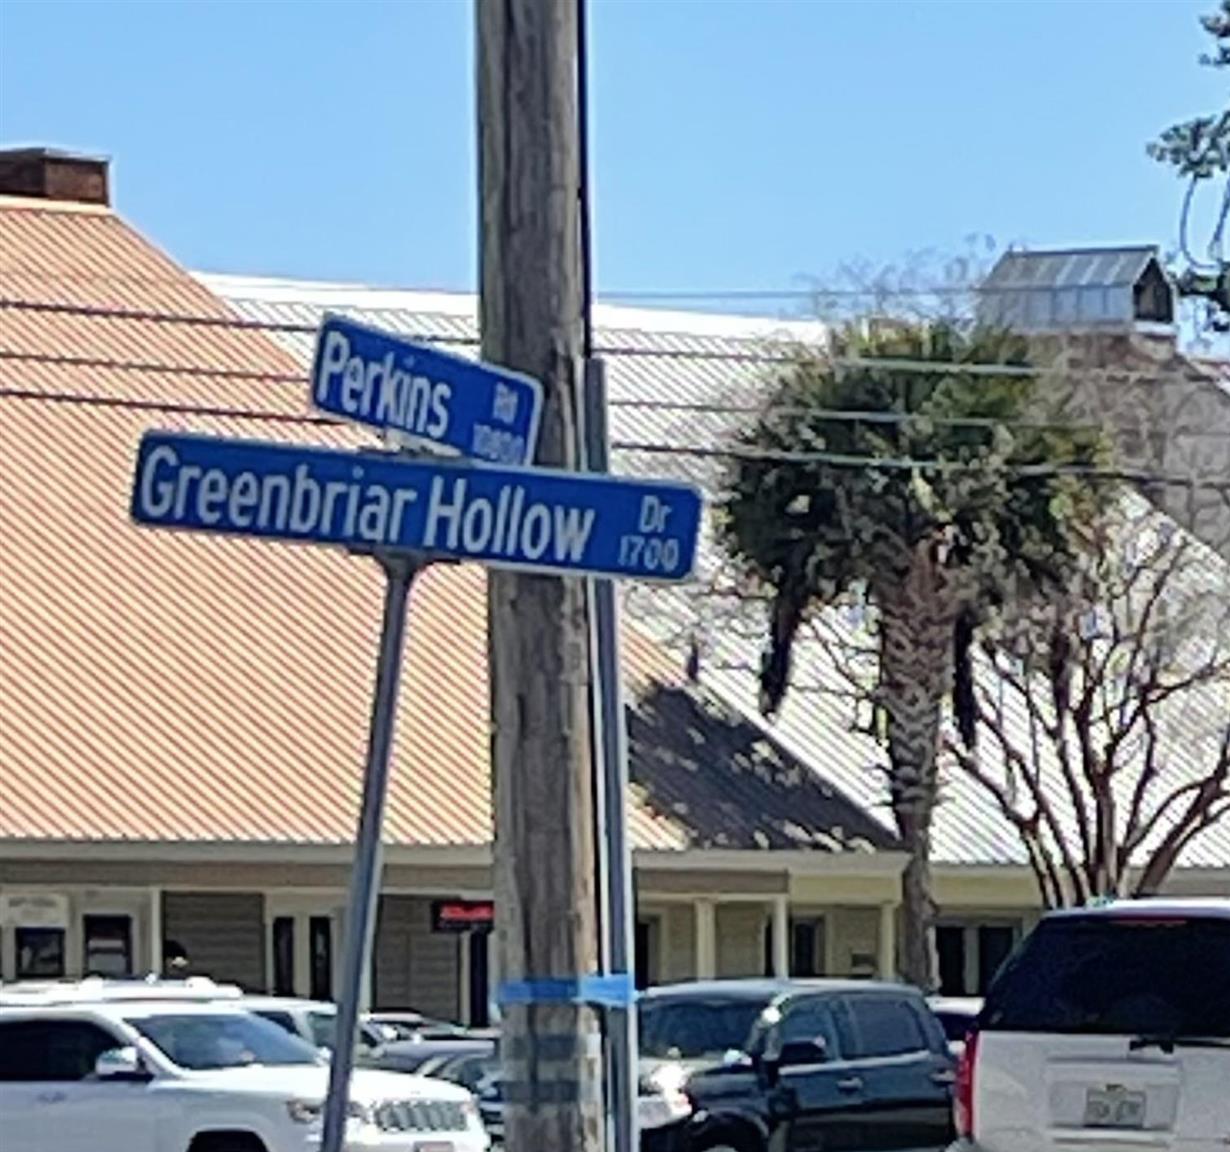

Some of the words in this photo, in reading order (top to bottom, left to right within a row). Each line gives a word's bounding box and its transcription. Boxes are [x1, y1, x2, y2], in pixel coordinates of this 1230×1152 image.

[316, 330, 452, 439] Perkins
[139, 445, 418, 545] Greenbriar
[422, 475, 596, 562] Hollow
[638, 494, 673, 533] Dr
[617, 535, 679, 571] 1700
